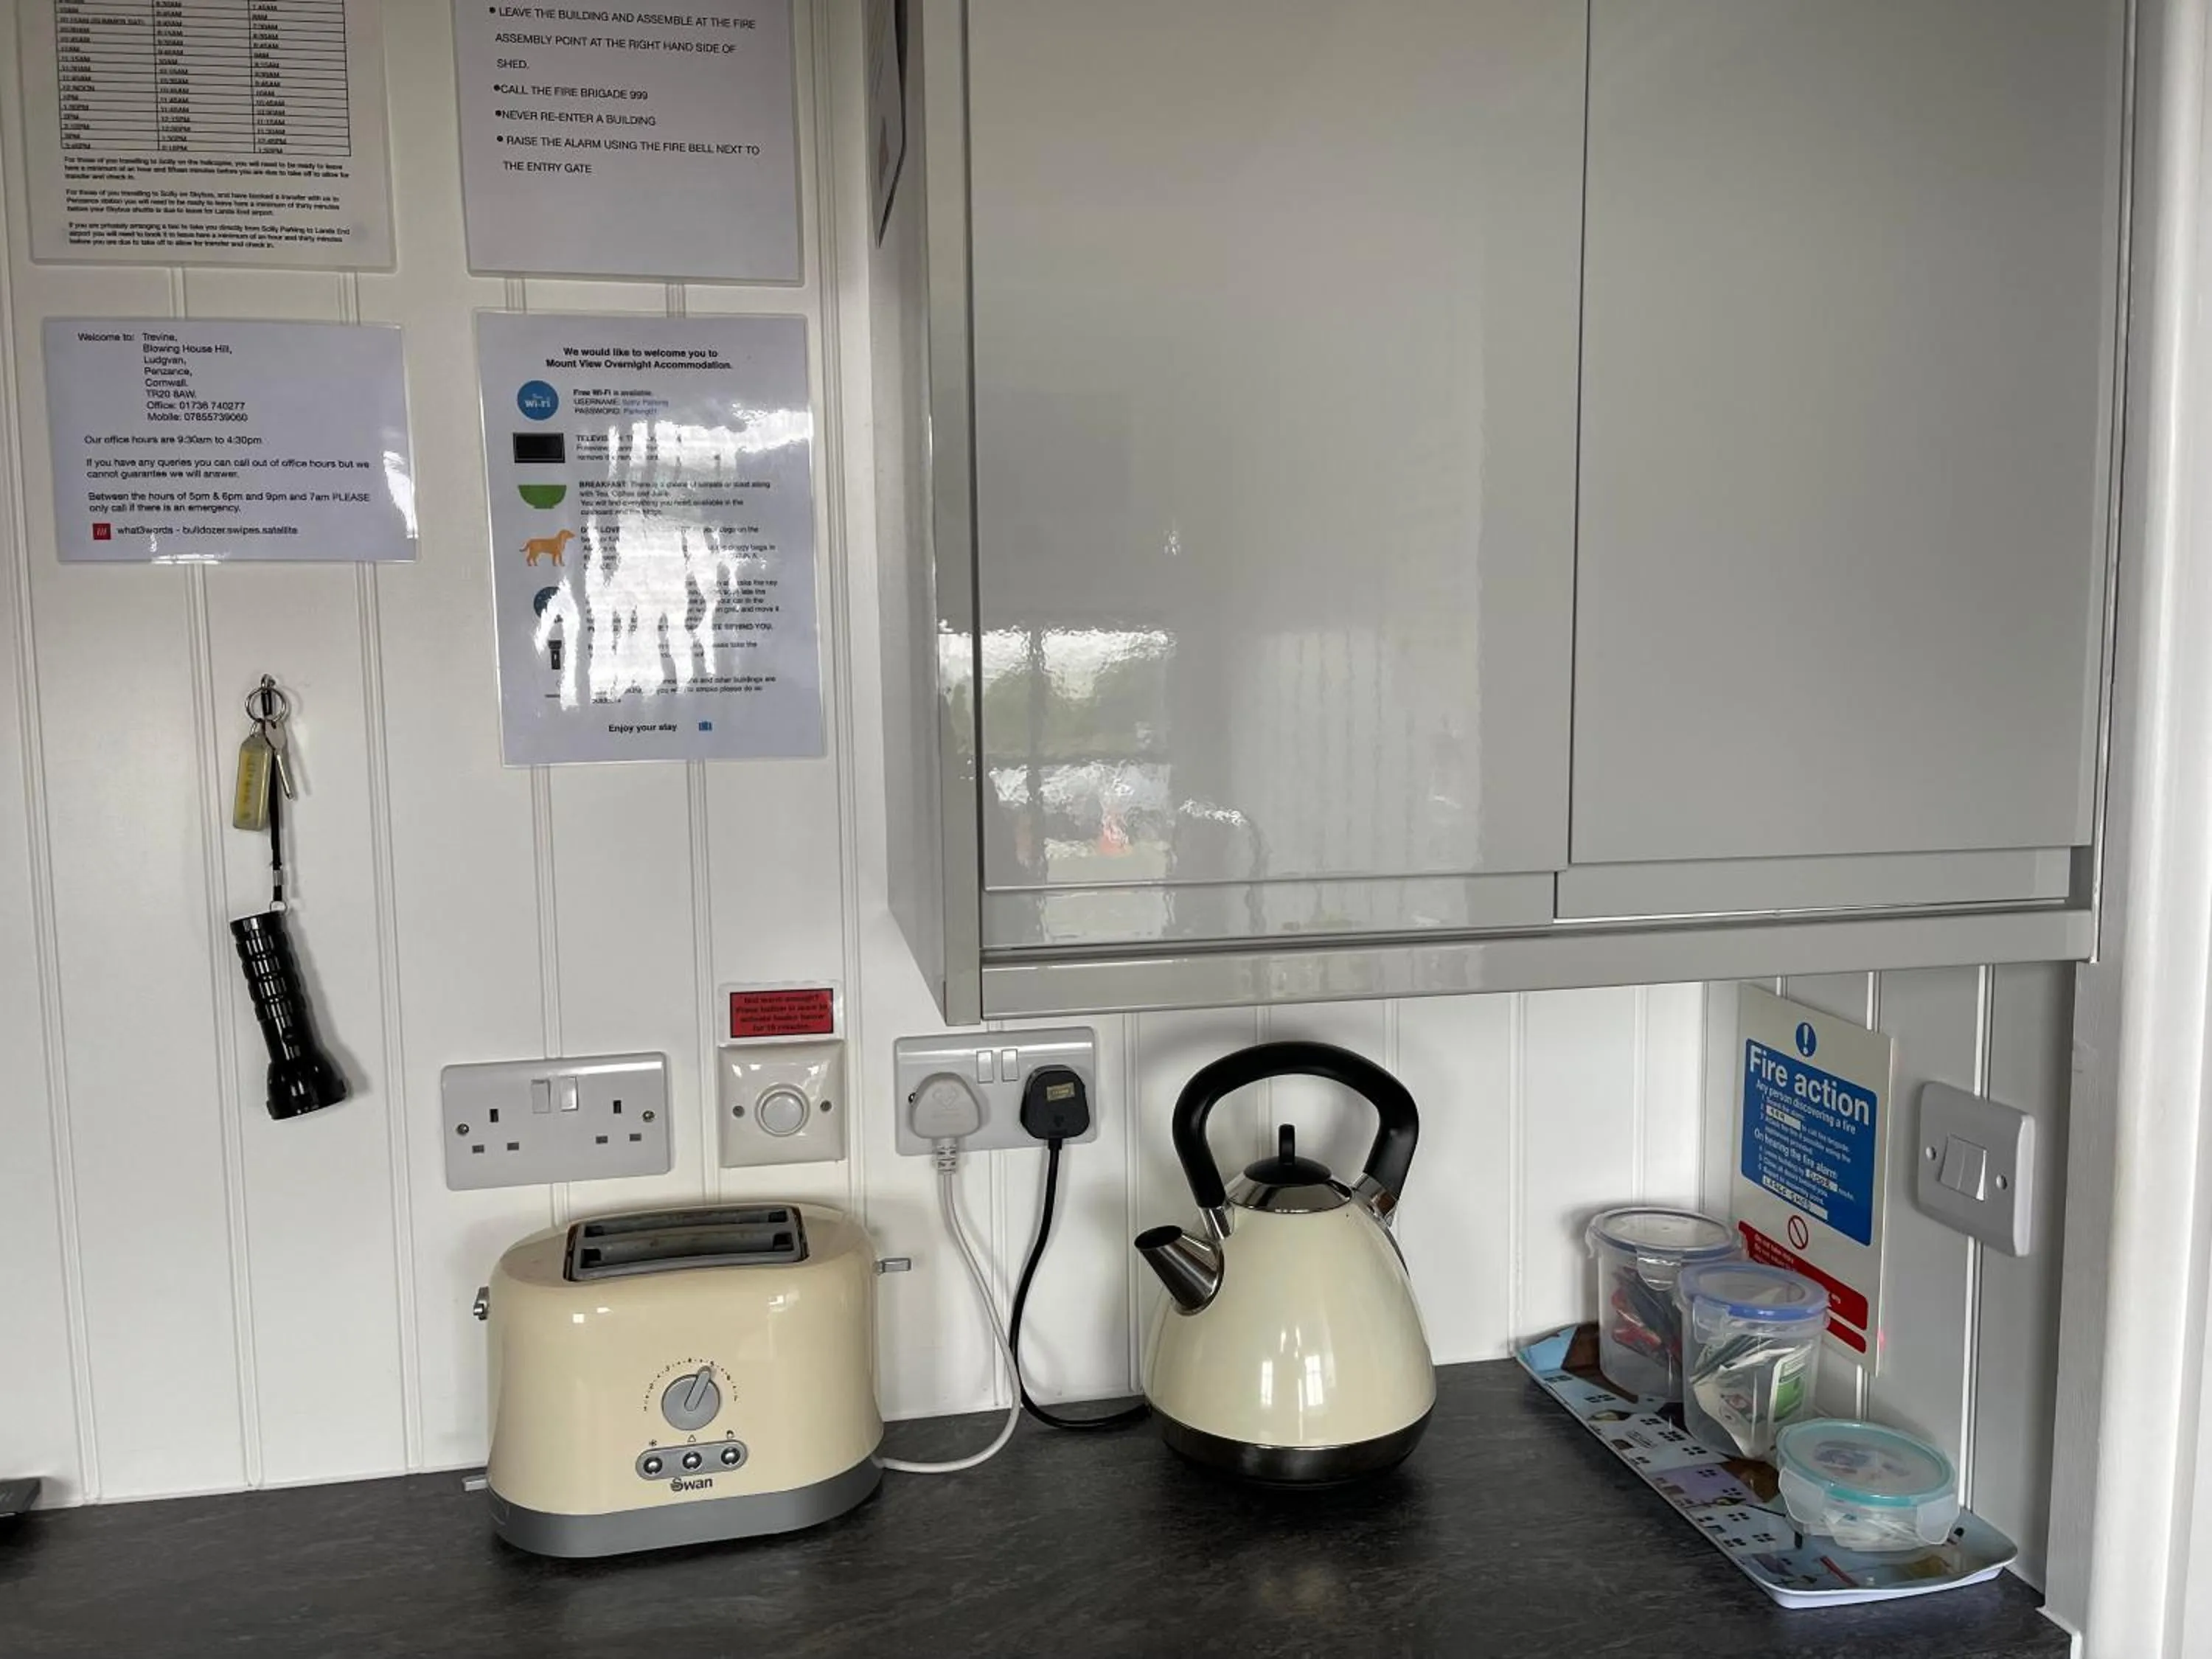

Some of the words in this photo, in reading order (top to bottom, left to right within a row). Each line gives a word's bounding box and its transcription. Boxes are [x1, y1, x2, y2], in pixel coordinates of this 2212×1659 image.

[498, 7, 531, 17] LEAVE
[535, 8, 554, 18] THE
[557, 9, 610, 21] BUILDING
[611, 12, 634, 23] AND
[636, 13, 693, 25] ASSEMBLE
[695, 17, 708, 27] AT
[709, 17, 730, 27] THE
[733, 18, 755, 29] FIRE
[495, 33, 552, 44] ASSEMBLY
[555, 35, 587, 47] POINT
[589, 37, 602, 46] AT
[606, 38, 625, 48] THE
[627, 38, 661, 50] RIGHT
[663, 41, 693, 52] HAND
[695, 42, 720, 53] SIDE
[721, 44, 735, 53] OF
[496, 58, 531, 69] SHED.
[501, 83, 528, 96] CALL
[531, 86, 552, 96] THE
[554, 86, 578, 96] FIRE
[580, 88, 627, 99] BRIGADE
[629, 91, 647, 100] 999
[501, 109, 538, 120] NEVER
[540, 111, 593, 125] RE-ENTER
[595, 114, 603, 125] A
[605, 114, 655, 125] BUILDING
[507, 135, 537, 145] RAISE
[540, 136, 560, 147] THE
[565, 137, 601, 148] ALARM
[604, 139, 637, 149] USING
[639, 141, 661, 150] THE
[663, 142, 686, 152] FIRE
[687, 143, 714, 153] BELL
[716, 143, 742, 153] NEXT
[744, 145, 759, 155] TO
[502, 160, 524, 170] THE
[526, 161, 562, 173] ENTRY
[564, 163, 591, 174] GATE
[77, 332, 120, 341] Welcome
[142, 332, 177, 341] Trevine,
[142, 343, 180, 354] Blowing
[182, 344, 212, 352] House
[215, 344, 232, 353] Hill,
[563, 347, 578, 356] We
[580, 347, 610, 358] would
[613, 348, 630, 356] like
[644, 348, 686, 357] welcome
[688, 350, 706, 358] you
[144, 355, 186, 366] Ludgvan,
[545, 358, 577, 367] Mount
[578, 359, 602, 368] View
[604, 359, 651, 370] Overnight
[144, 366, 192, 376] Penzance,
[146, 389, 170, 398] TR20
[146, 400, 176, 410] Office:
[211, 401, 245, 411] 740277
[147, 412, 181, 421] Mobile:
[84, 435, 102, 443] Our
[103, 435, 129, 444] office
[215, 436, 224, 445] to
[86, 458, 91, 466] If
[94, 459, 111, 468] you
[114, 459, 136, 467] have
[138, 459, 155, 467] any
[156, 459, 192, 467] queries
[194, 459, 211, 468] you
[233, 458, 249, 466] call
[281, 459, 307, 467] office
[309, 459, 336, 470] hours
[337, 459, 354, 468] but
[86, 470, 118, 478] cannot
[120, 469, 167, 479] guarantee
[185, 469, 201, 477] will
[88, 491, 129, 500] Between
[131, 491, 146, 500] the
[148, 492, 174, 500] hours
[176, 491, 186, 500] of
[189, 492, 210, 501] 5pm
[212, 492, 220, 500] &
[221, 492, 243, 501] 6pm
[246, 492, 263, 500] and
[265, 492, 287, 502] 9pm
[310, 492, 329, 501] 7am
[333, 493, 369, 501] PLEASE
[89, 504, 108, 513] only
[111, 504, 127, 512] call
[129, 503, 134, 511] if
[136, 504, 161, 512] there
[163, 503, 171, 511] is
[187, 504, 240, 513] emergency.
[116, 525, 173, 535] what3words
[608, 724, 633, 734] Enjoy
[636, 725, 656, 733] your
[658, 723, 677, 731] stay
[1750, 1045, 1788, 1087] Fire
[1795, 1073, 1869, 1125] action
[1756, 1079, 1767, 1094] Any
[1770, 1088, 1792, 1105] person
[1792, 1099, 1834, 1127] discovering
[1836, 1119, 1841, 1127] a
[1843, 1120, 1856, 1135] fire
[1754, 1127, 1764, 1142] On
[1765, 1133, 1790, 1157] hearing
[1790, 1147, 1801, 1161] the
[1803, 1154, 1815, 1168] fire
[671, 1478, 713, 1492] Swan
